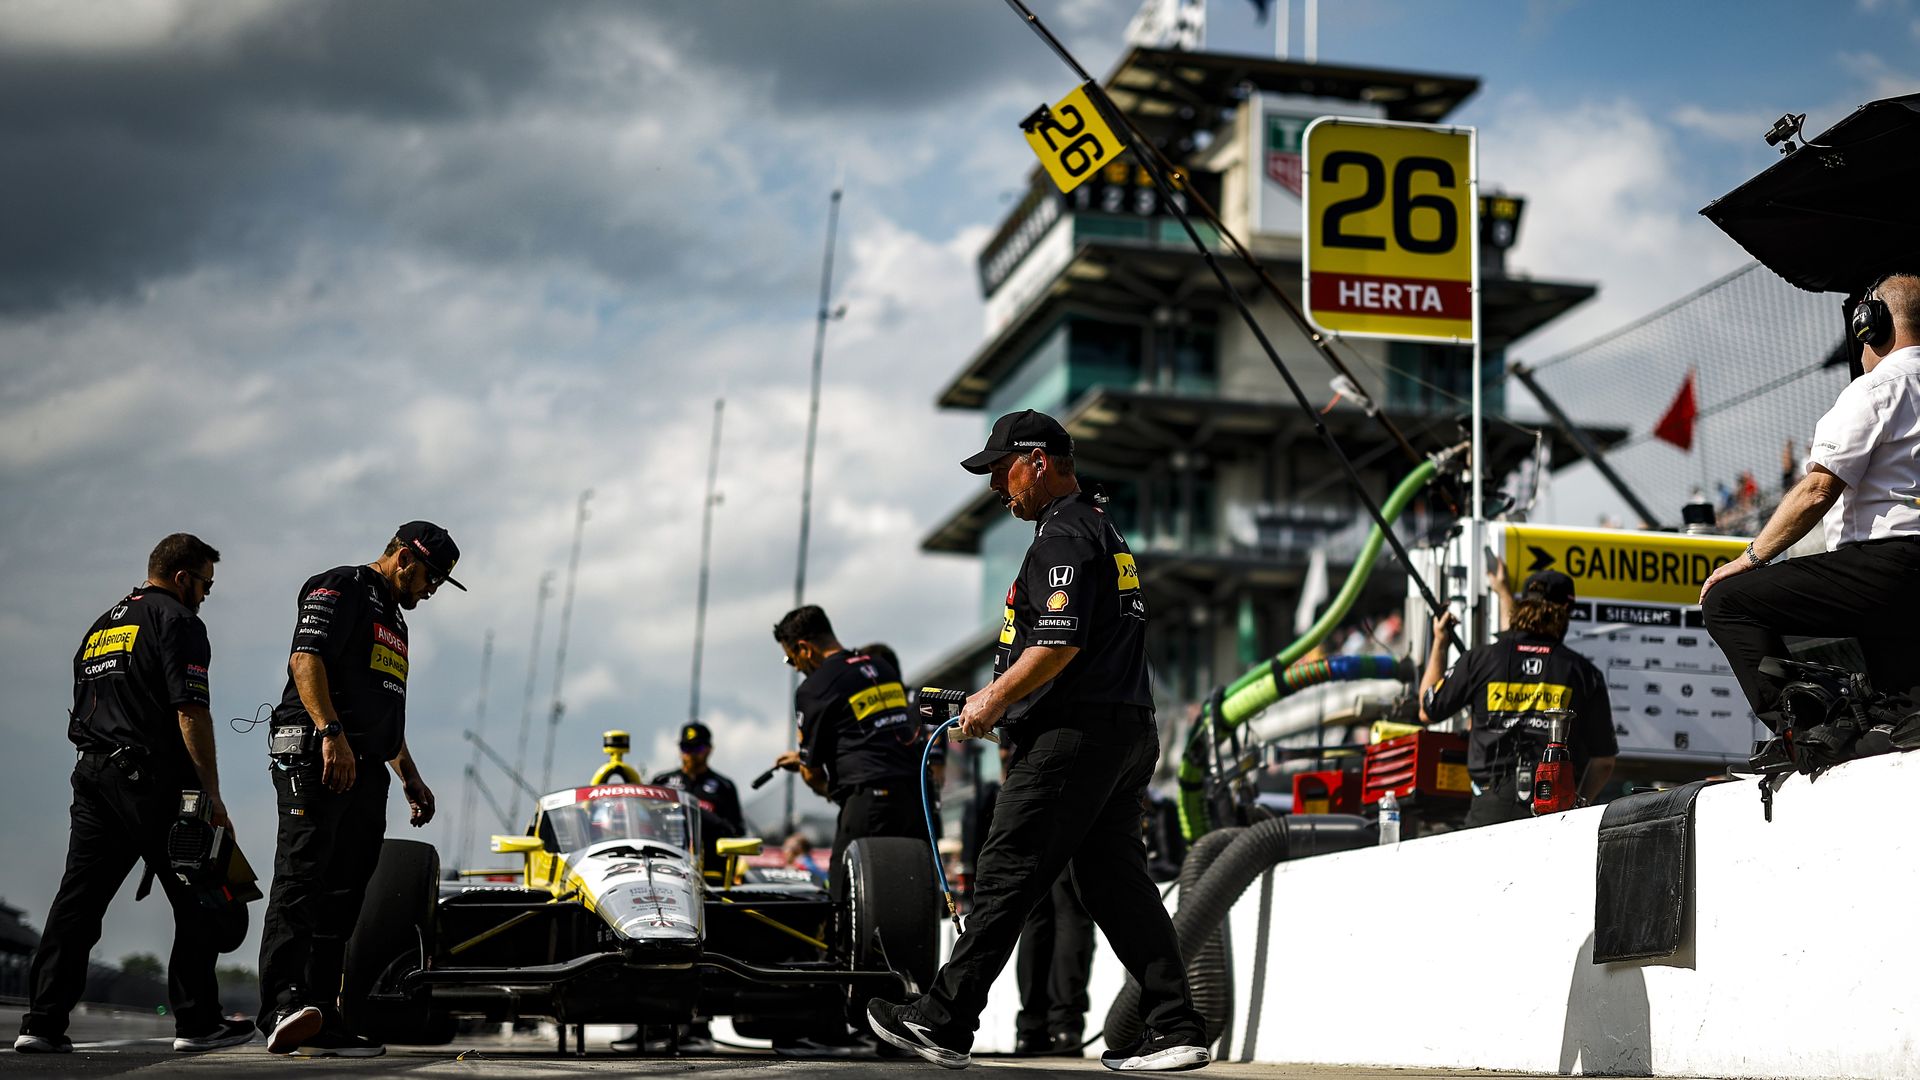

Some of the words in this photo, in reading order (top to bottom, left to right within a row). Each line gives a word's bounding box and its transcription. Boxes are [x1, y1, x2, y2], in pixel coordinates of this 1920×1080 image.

[1036, 104, 1105, 178] 26
[1321, 150, 1458, 255] 26
[1338, 280, 1443, 312] HERTA
[1606, 607, 1671, 624] SIEMENS
[588, 788, 670, 799] ANDRETTI
